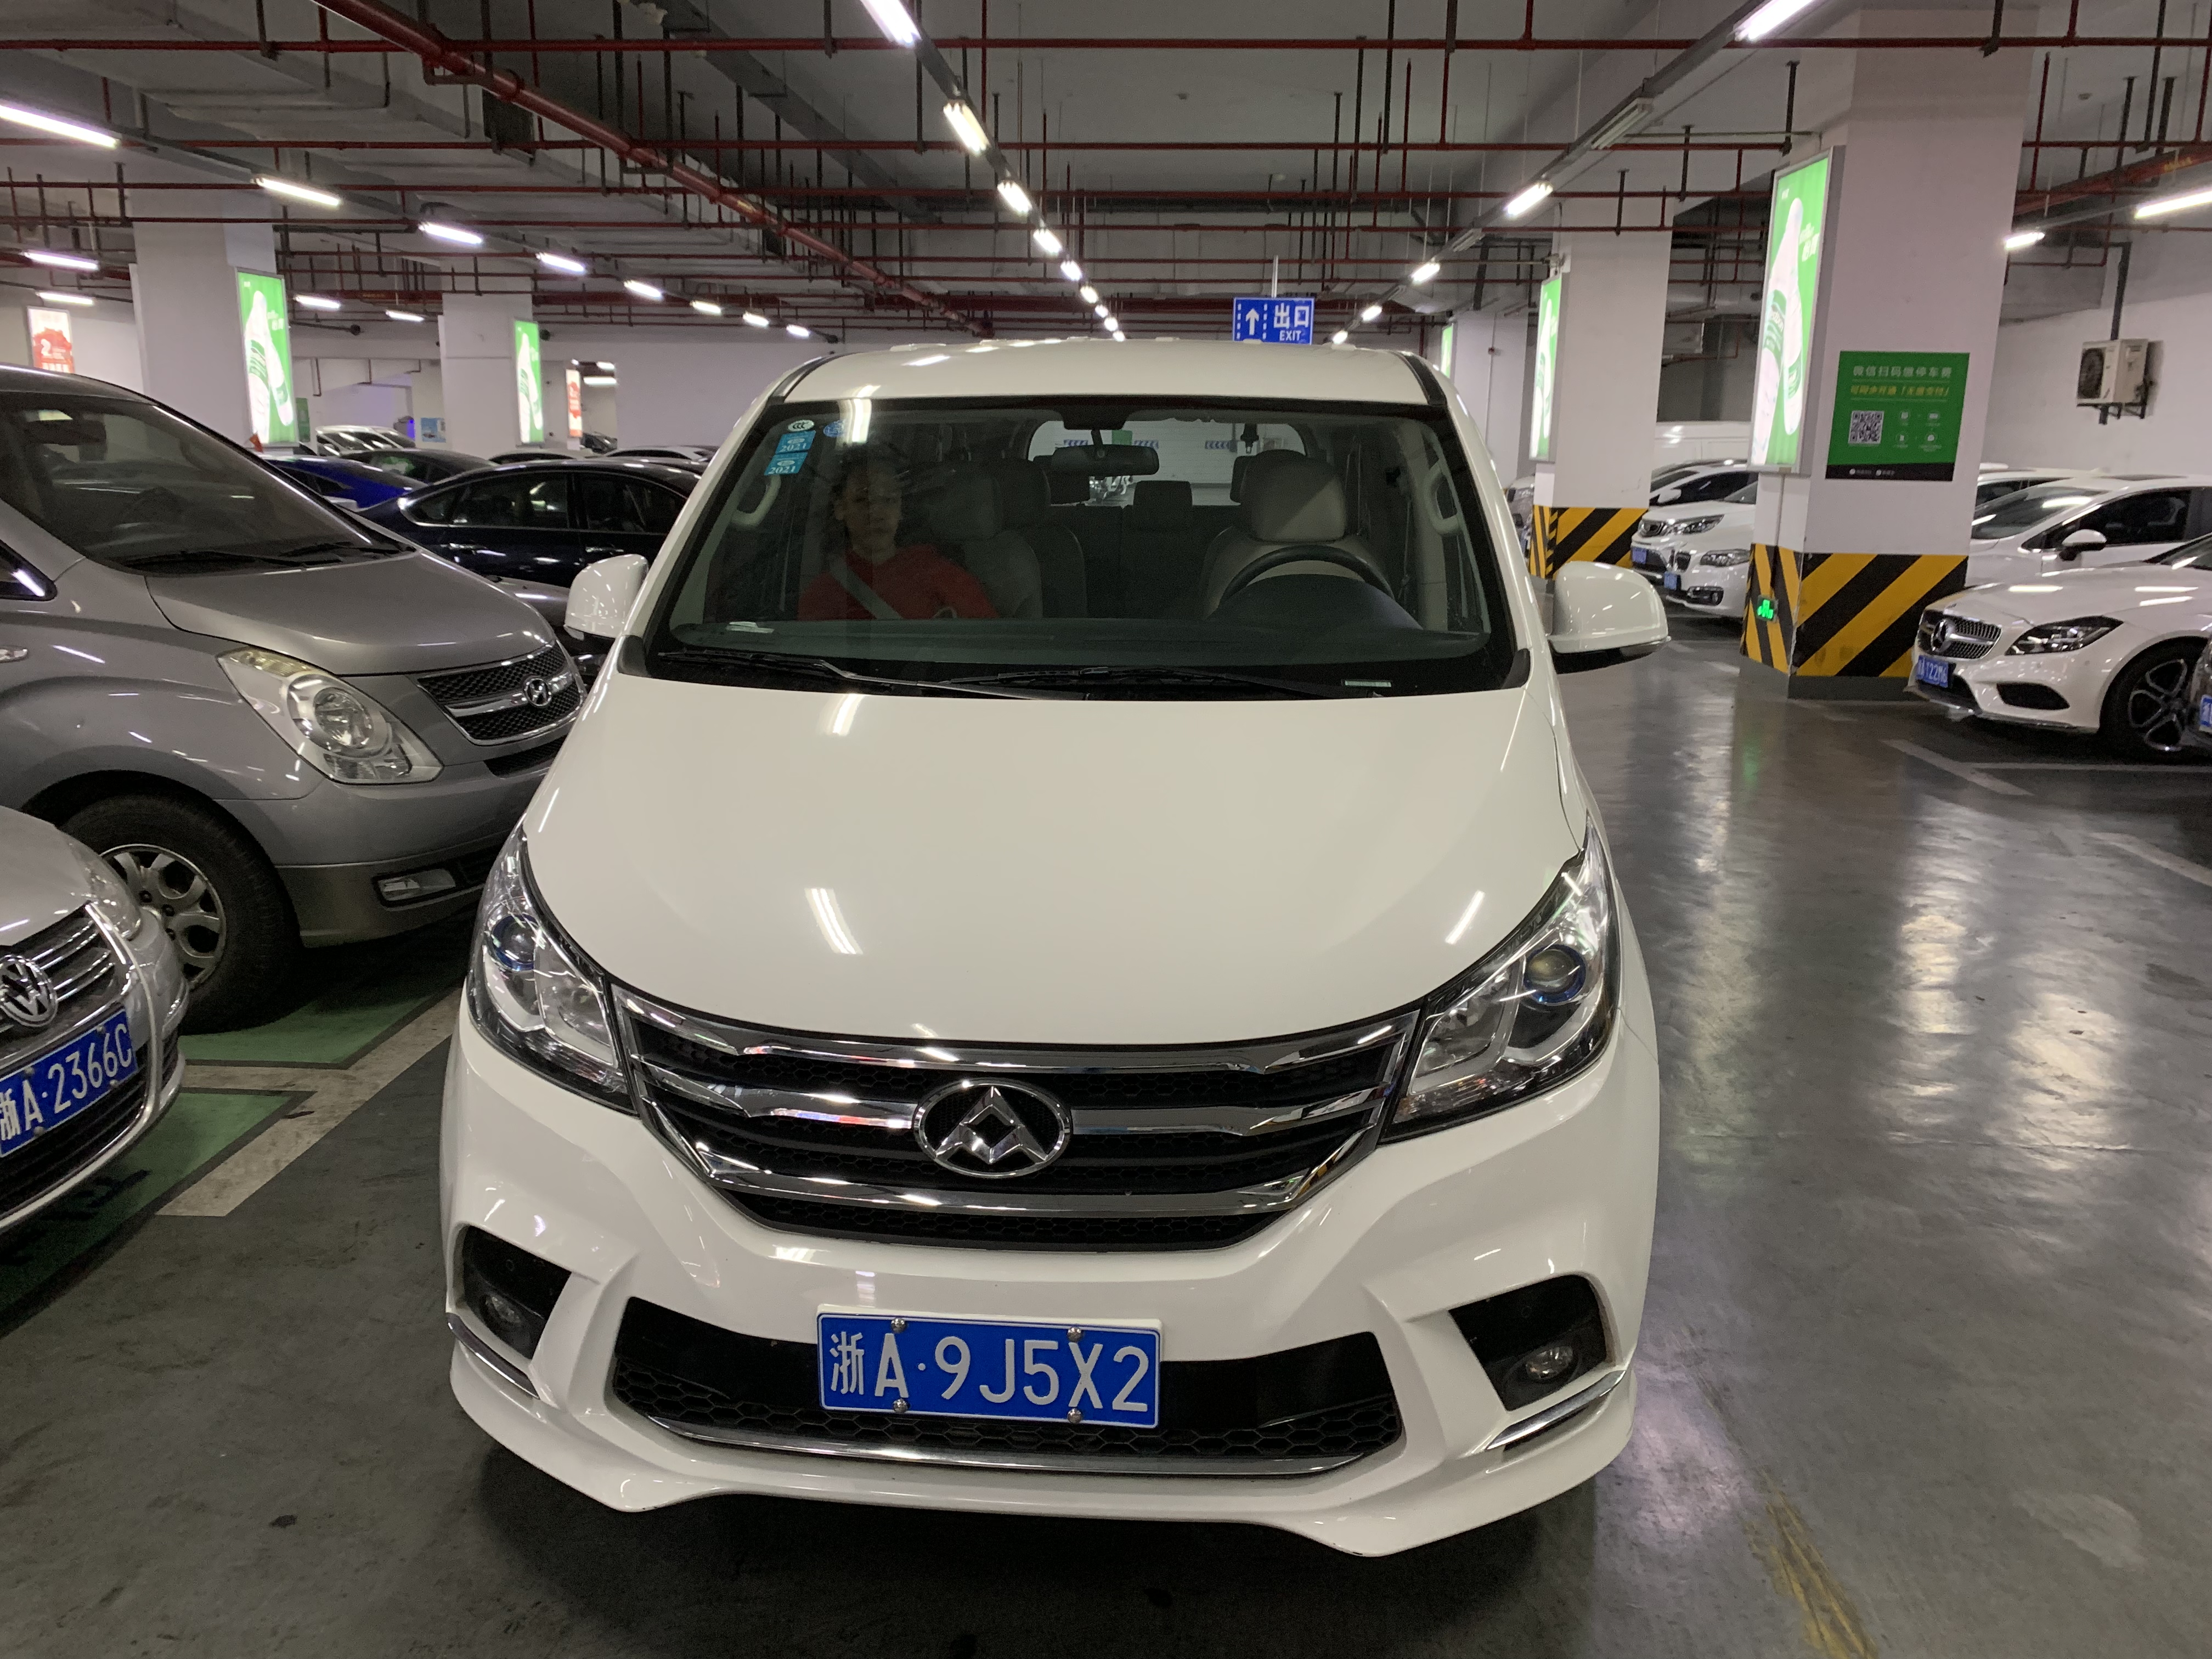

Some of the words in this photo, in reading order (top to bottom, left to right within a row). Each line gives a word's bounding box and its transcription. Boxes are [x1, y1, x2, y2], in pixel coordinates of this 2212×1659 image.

[1273, 302, 1310, 329] 出口
[1279, 330, 1302, 341] EXIT
[779, 443, 807, 453] 2021
[768, 466, 796, 475] 2021
[830, 1331, 1149, 1413] 浙A·9J5X2
